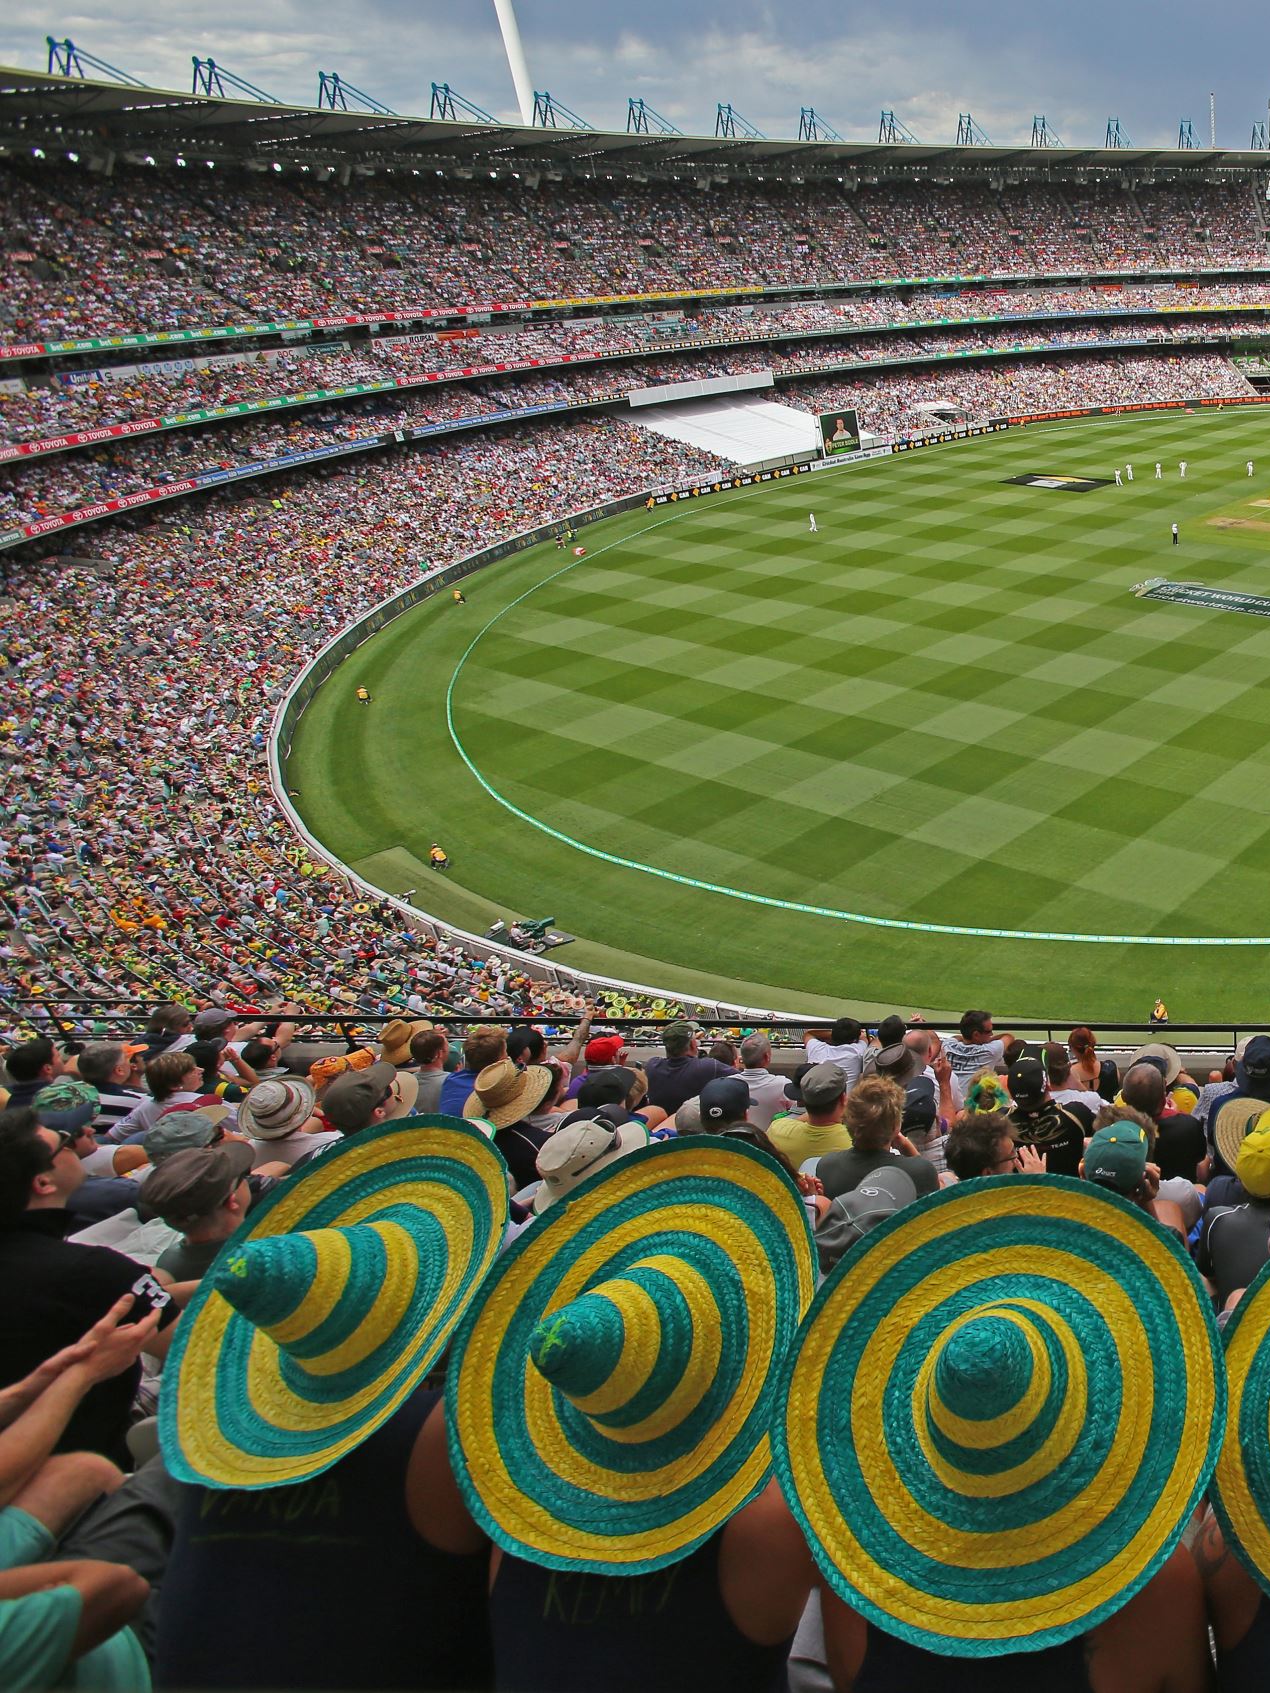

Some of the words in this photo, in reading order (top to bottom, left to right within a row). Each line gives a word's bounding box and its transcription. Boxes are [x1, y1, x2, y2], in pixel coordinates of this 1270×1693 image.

[402, 311, 423, 319] TOYOTA
[438, 308, 458, 316] TOYOTA
[326, 318, 348, 326] TOYOTA
[11, 345, 40, 355] TOYOTA
[277, 350, 294, 358] BOC
[478, 365, 497, 373] TOYOTA
[513, 361, 531, 369] TOYOTA
[445, 370, 464, 378] TOYOTA
[408, 376, 429, 384] TOYOTA
[130, 421, 157, 432] TOYOTA
[87, 430, 113, 441] TOYOTA
[40, 439, 69, 450] TOYOTA
[167, 482, 192, 493] TOYOTA
[126, 493, 151, 504] TOYOTA
[678, 491, 690, 499] CAN
[83, 505, 109, 517] TOYOTA
[40, 518, 65, 530] TOYOTA
[1160, 584, 1213, 598] CRICKET
[1211, 592, 1254, 605] WORLD
[1051, 1141, 1069, 1150] TEAM
[1101, 1169, 1117, 1177] asics
[131, 1273, 172, 1308] 3
